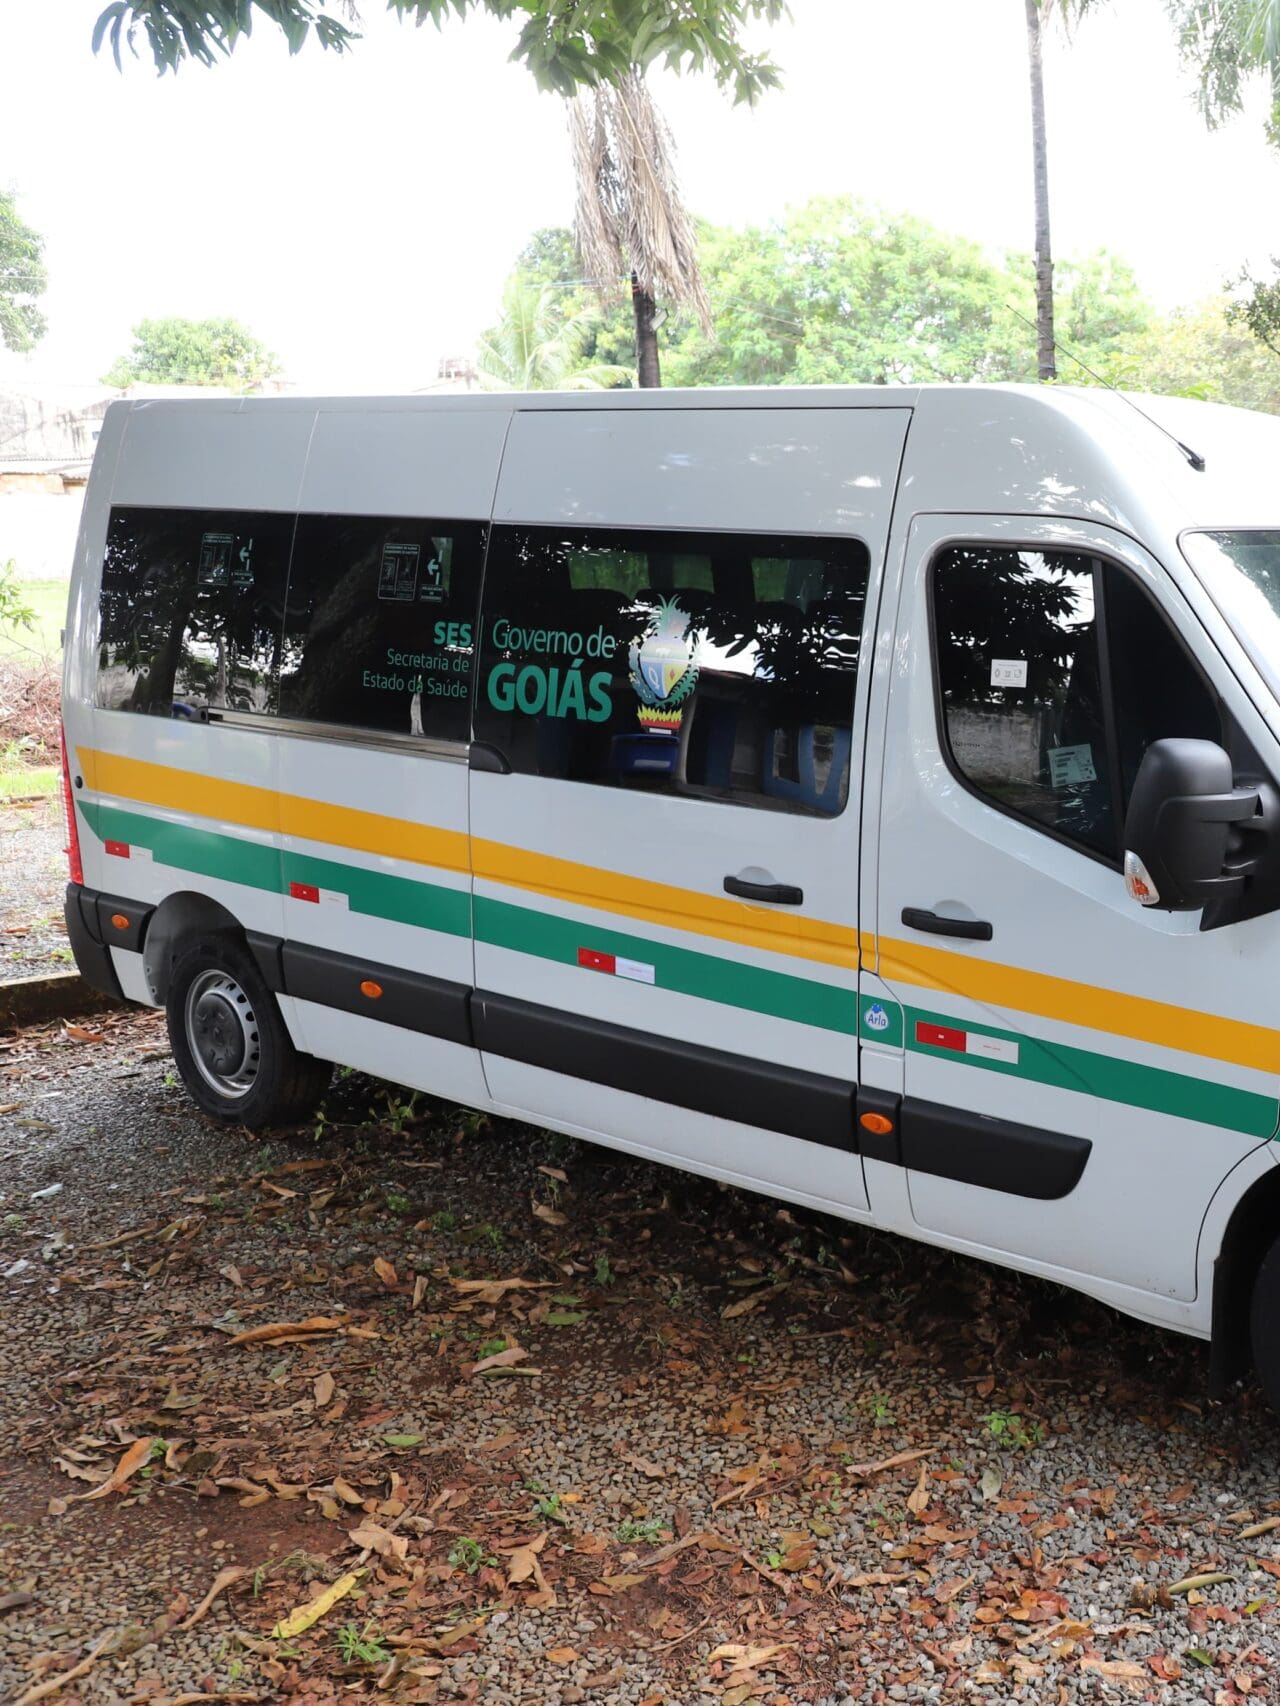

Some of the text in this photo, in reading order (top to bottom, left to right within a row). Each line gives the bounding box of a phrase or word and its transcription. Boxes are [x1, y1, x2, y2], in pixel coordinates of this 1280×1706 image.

[434, 621, 472, 647] SES
[492, 618, 616, 659] Governo de
[387, 648, 470, 673] Secretaria de
[362, 670, 468, 698] Estado da Saúde
[487, 658, 613, 723] GOIÁS
[868, 1013, 887, 1027] Arla
